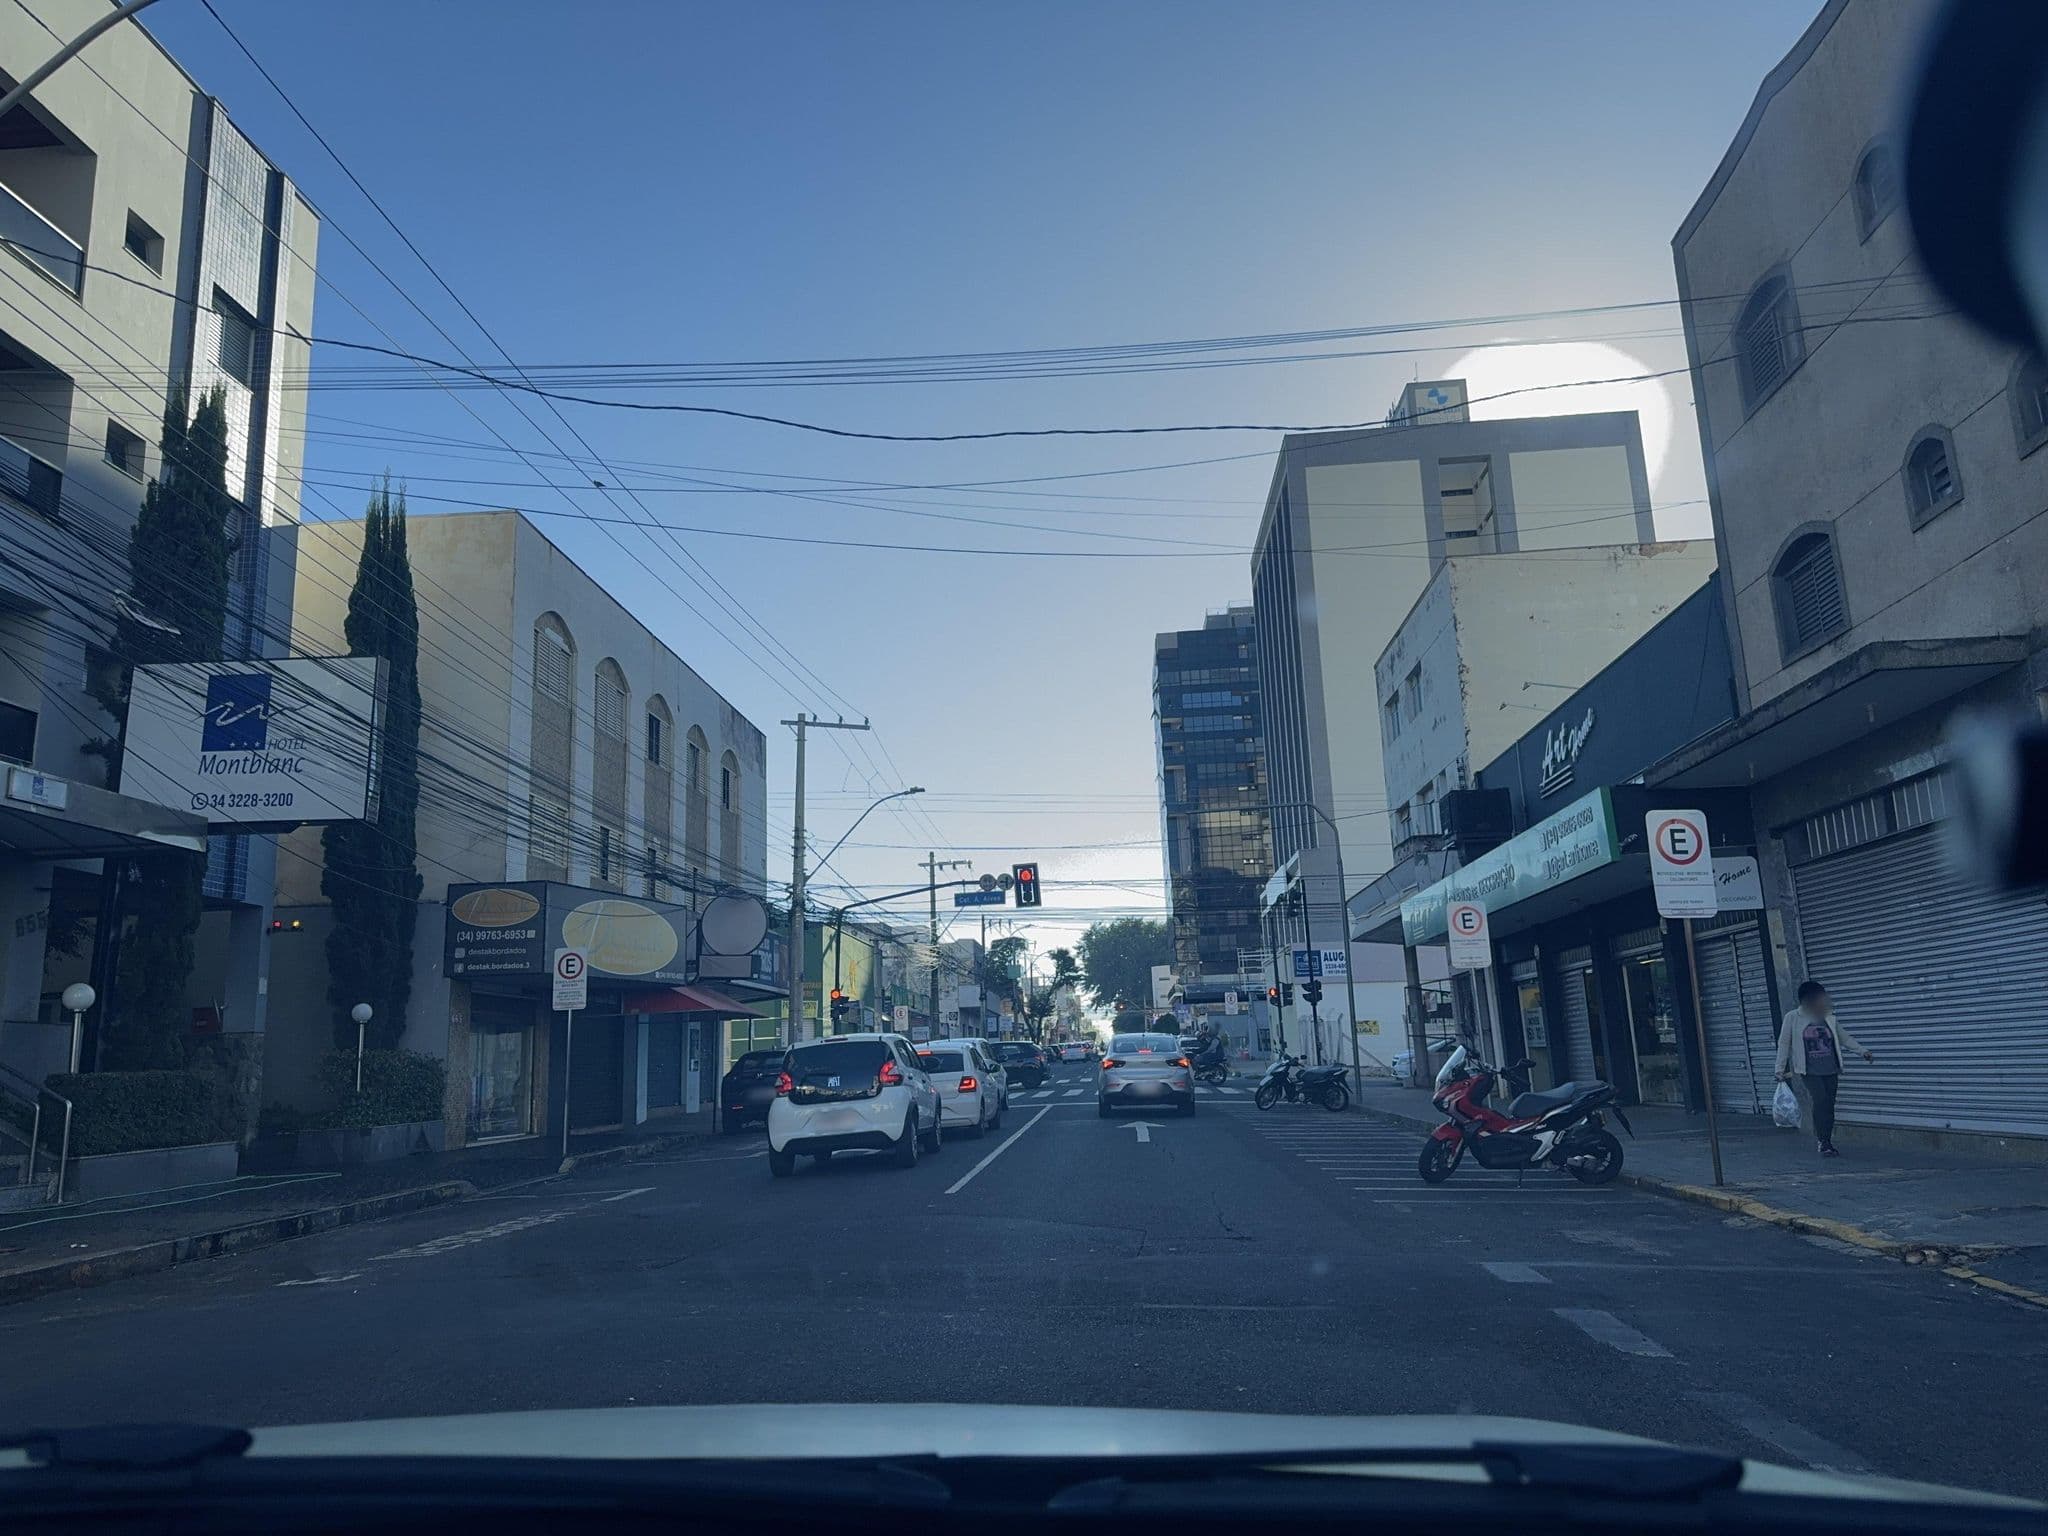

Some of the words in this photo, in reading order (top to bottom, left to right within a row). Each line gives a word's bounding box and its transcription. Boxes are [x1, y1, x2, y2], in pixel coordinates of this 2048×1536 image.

[267, 738, 307, 750] HOTEL
[1541, 722, 1567, 785] Art
[198, 752, 306, 776] Montblanc
[211, 794, 225, 808] 34
[228, 793, 293, 808] 3228-3200
[1669, 828, 1689, 855] E
[1718, 866, 1752, 886] Home
[1462, 912, 1474, 930] E
[456, 931, 474, 943] (34)
[476, 929, 526, 941] 99763-6953
[565, 958, 576, 974] E
